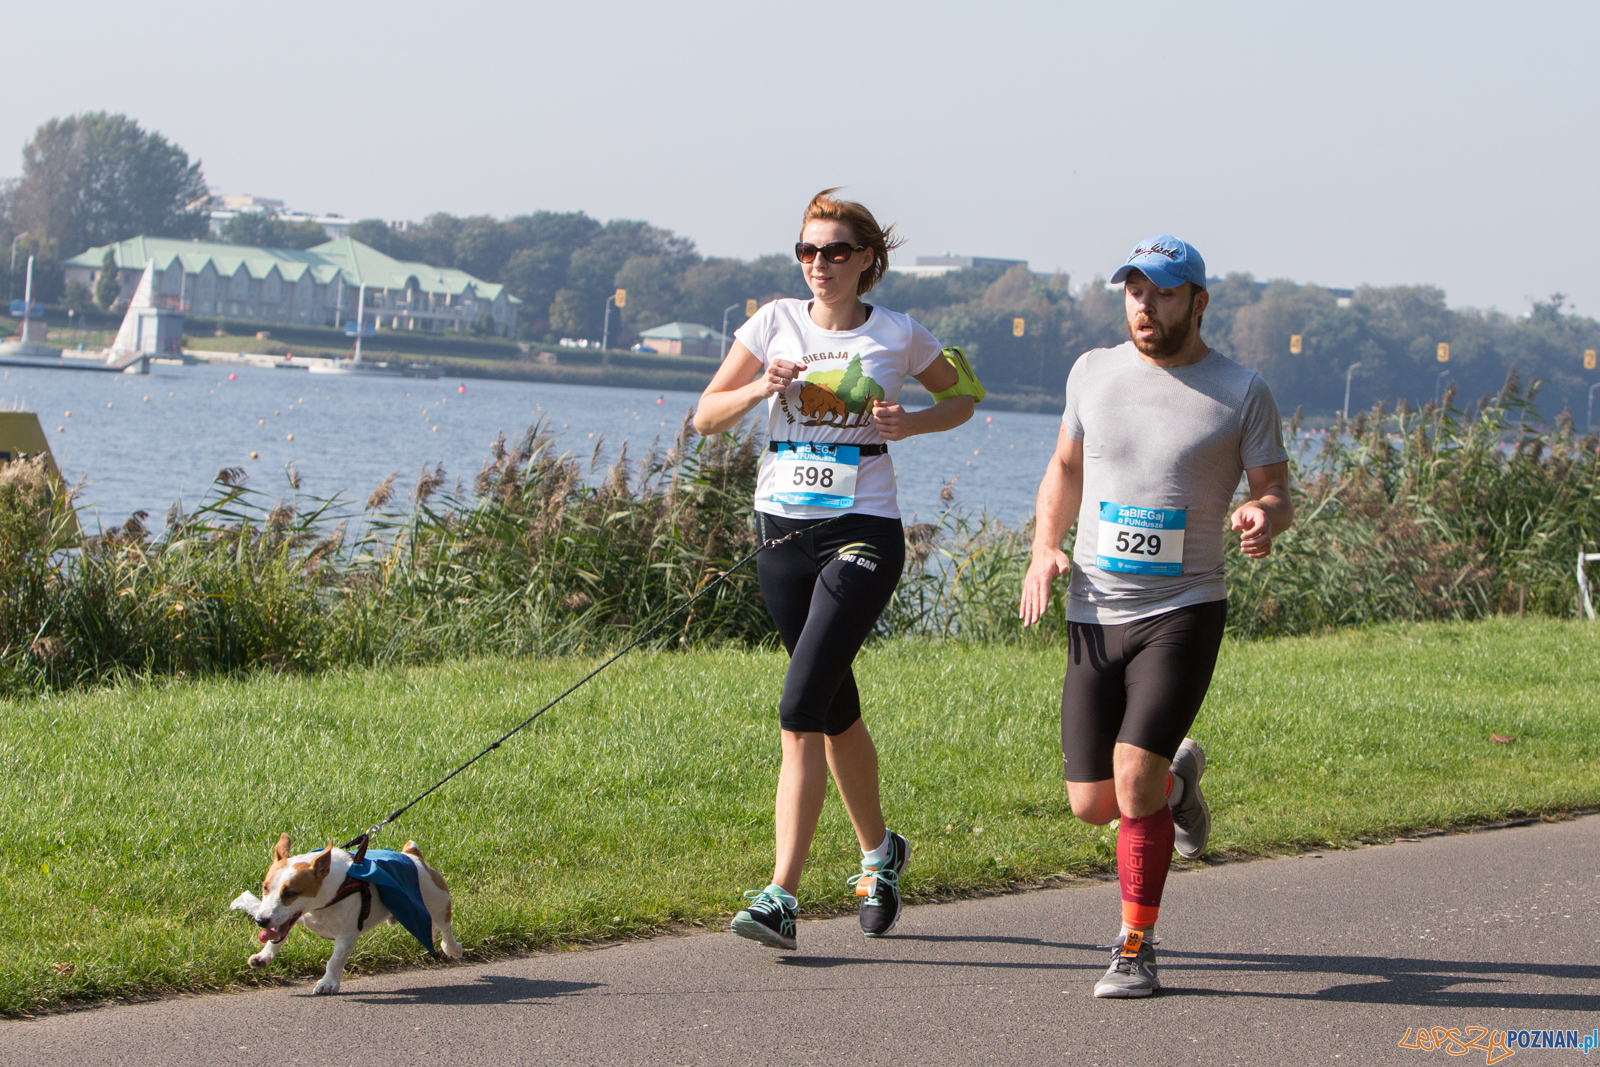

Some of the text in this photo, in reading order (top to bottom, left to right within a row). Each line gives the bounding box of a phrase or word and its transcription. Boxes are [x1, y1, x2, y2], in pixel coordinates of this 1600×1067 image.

[801, 351, 849, 365] BIEGAJĄ
[792, 466, 834, 489] 598
[1117, 517, 1164, 529] o FUNdusze
[1118, 508, 1165, 523] zaBIEGaj
[1115, 530, 1162, 557] 529
[856, 557, 878, 572] CAN
